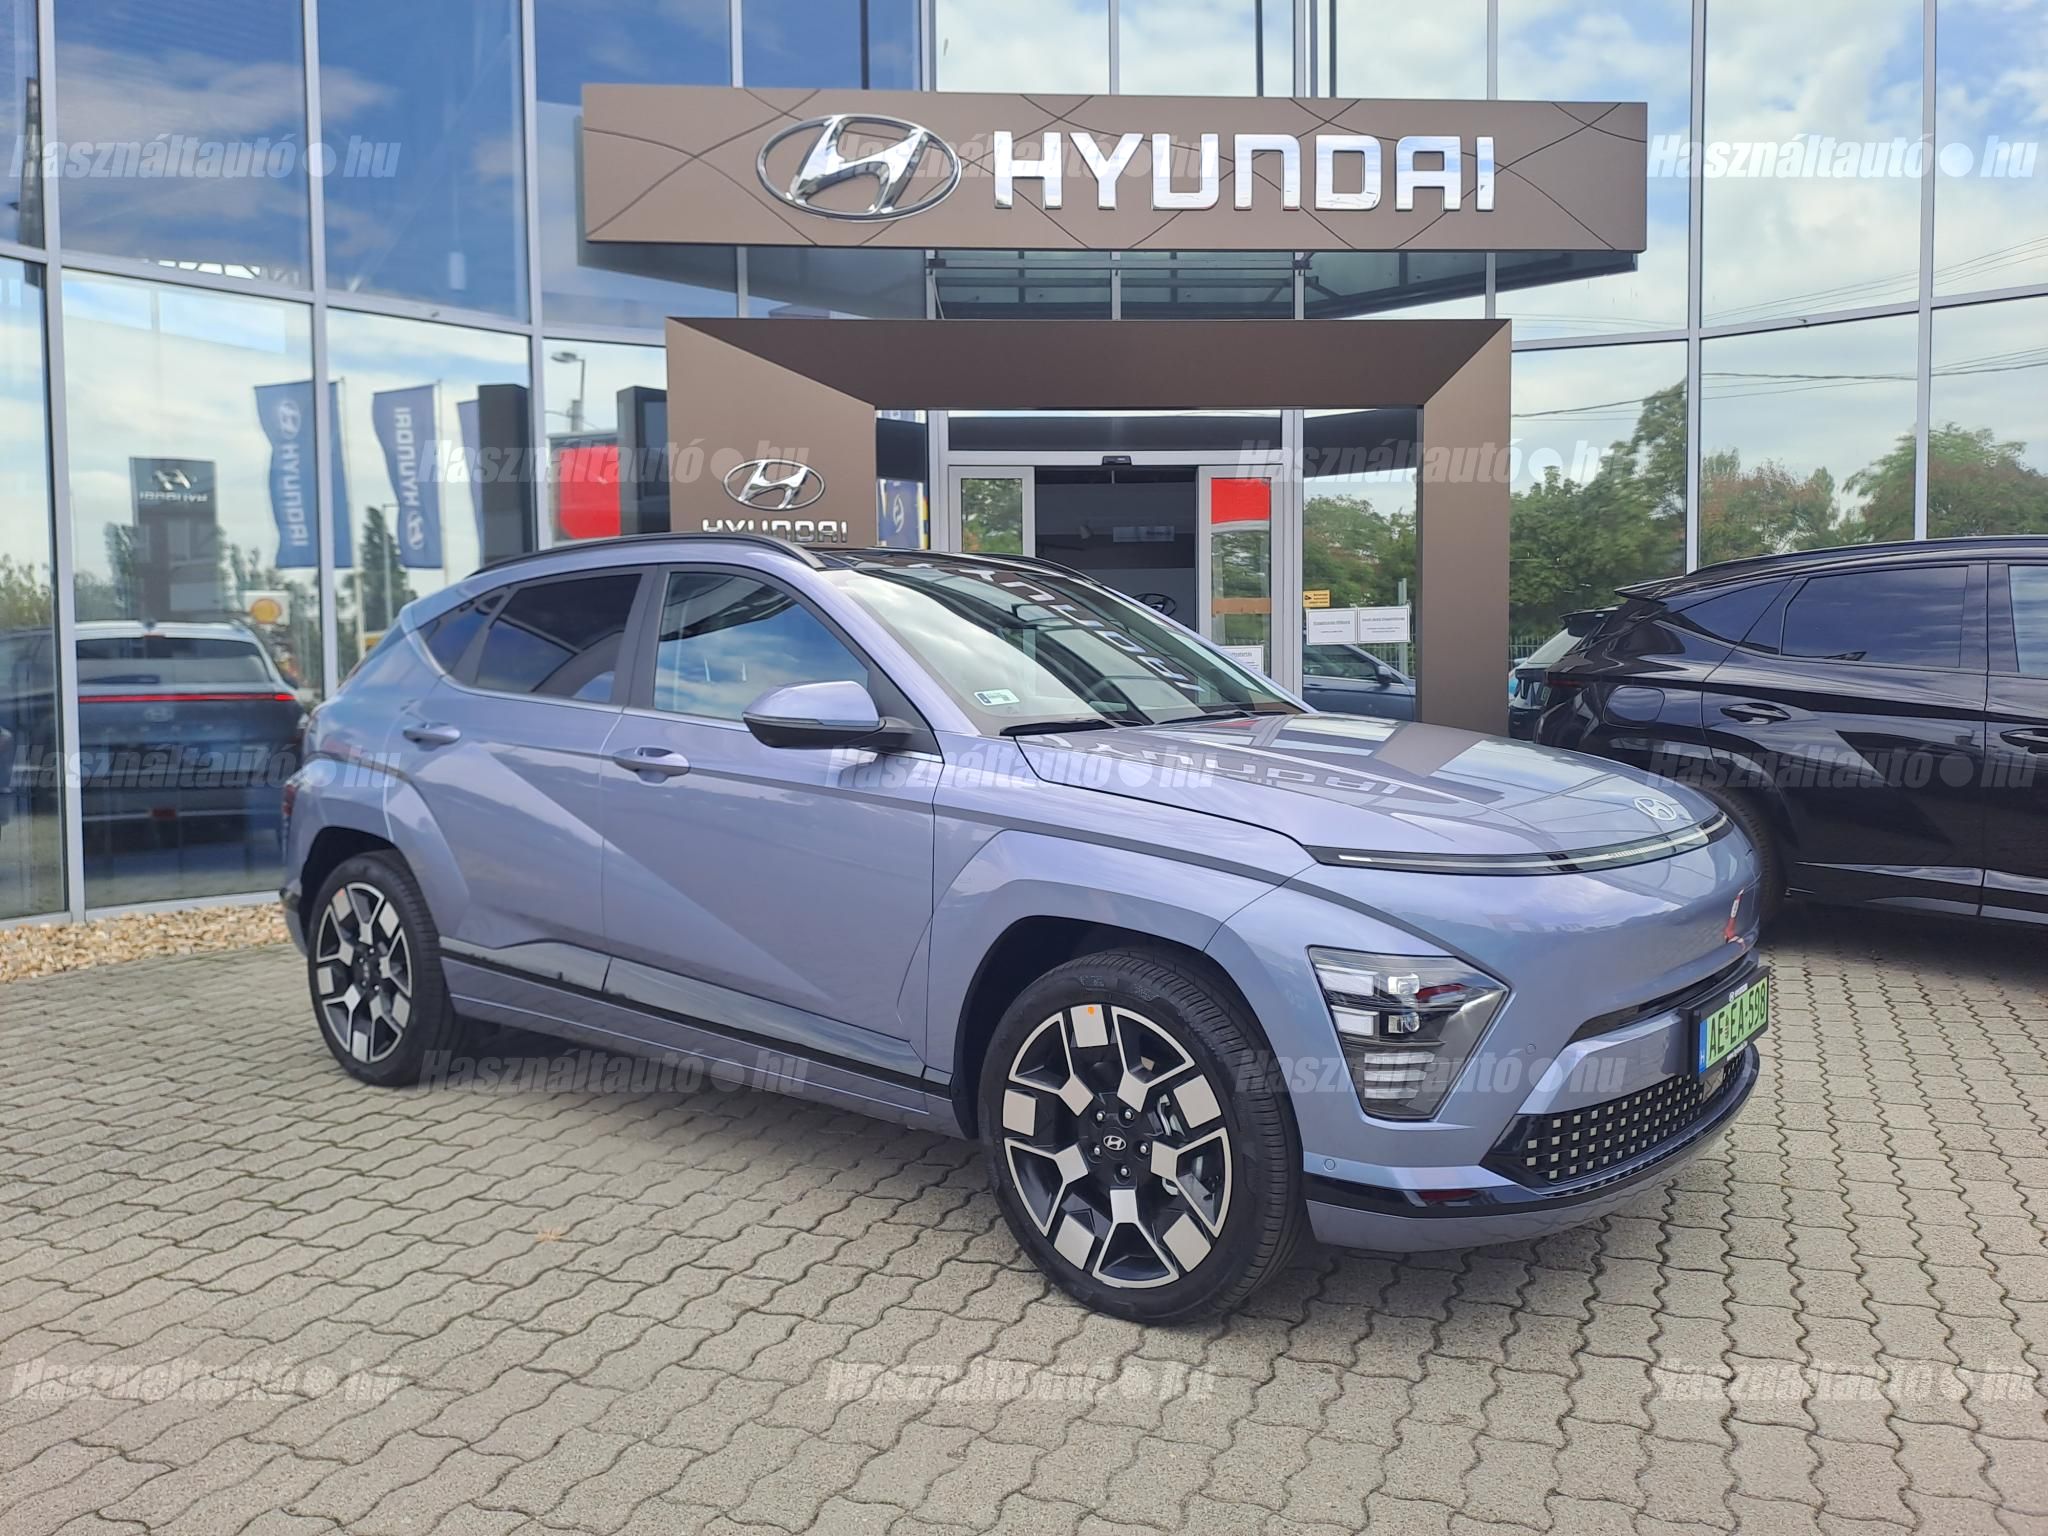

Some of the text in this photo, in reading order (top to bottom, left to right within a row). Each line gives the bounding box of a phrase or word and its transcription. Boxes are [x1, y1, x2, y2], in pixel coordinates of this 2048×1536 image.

[993, 130, 1495, 211] HYUNDAI
[1709, 981, 1766, 1061] AE EA-598
